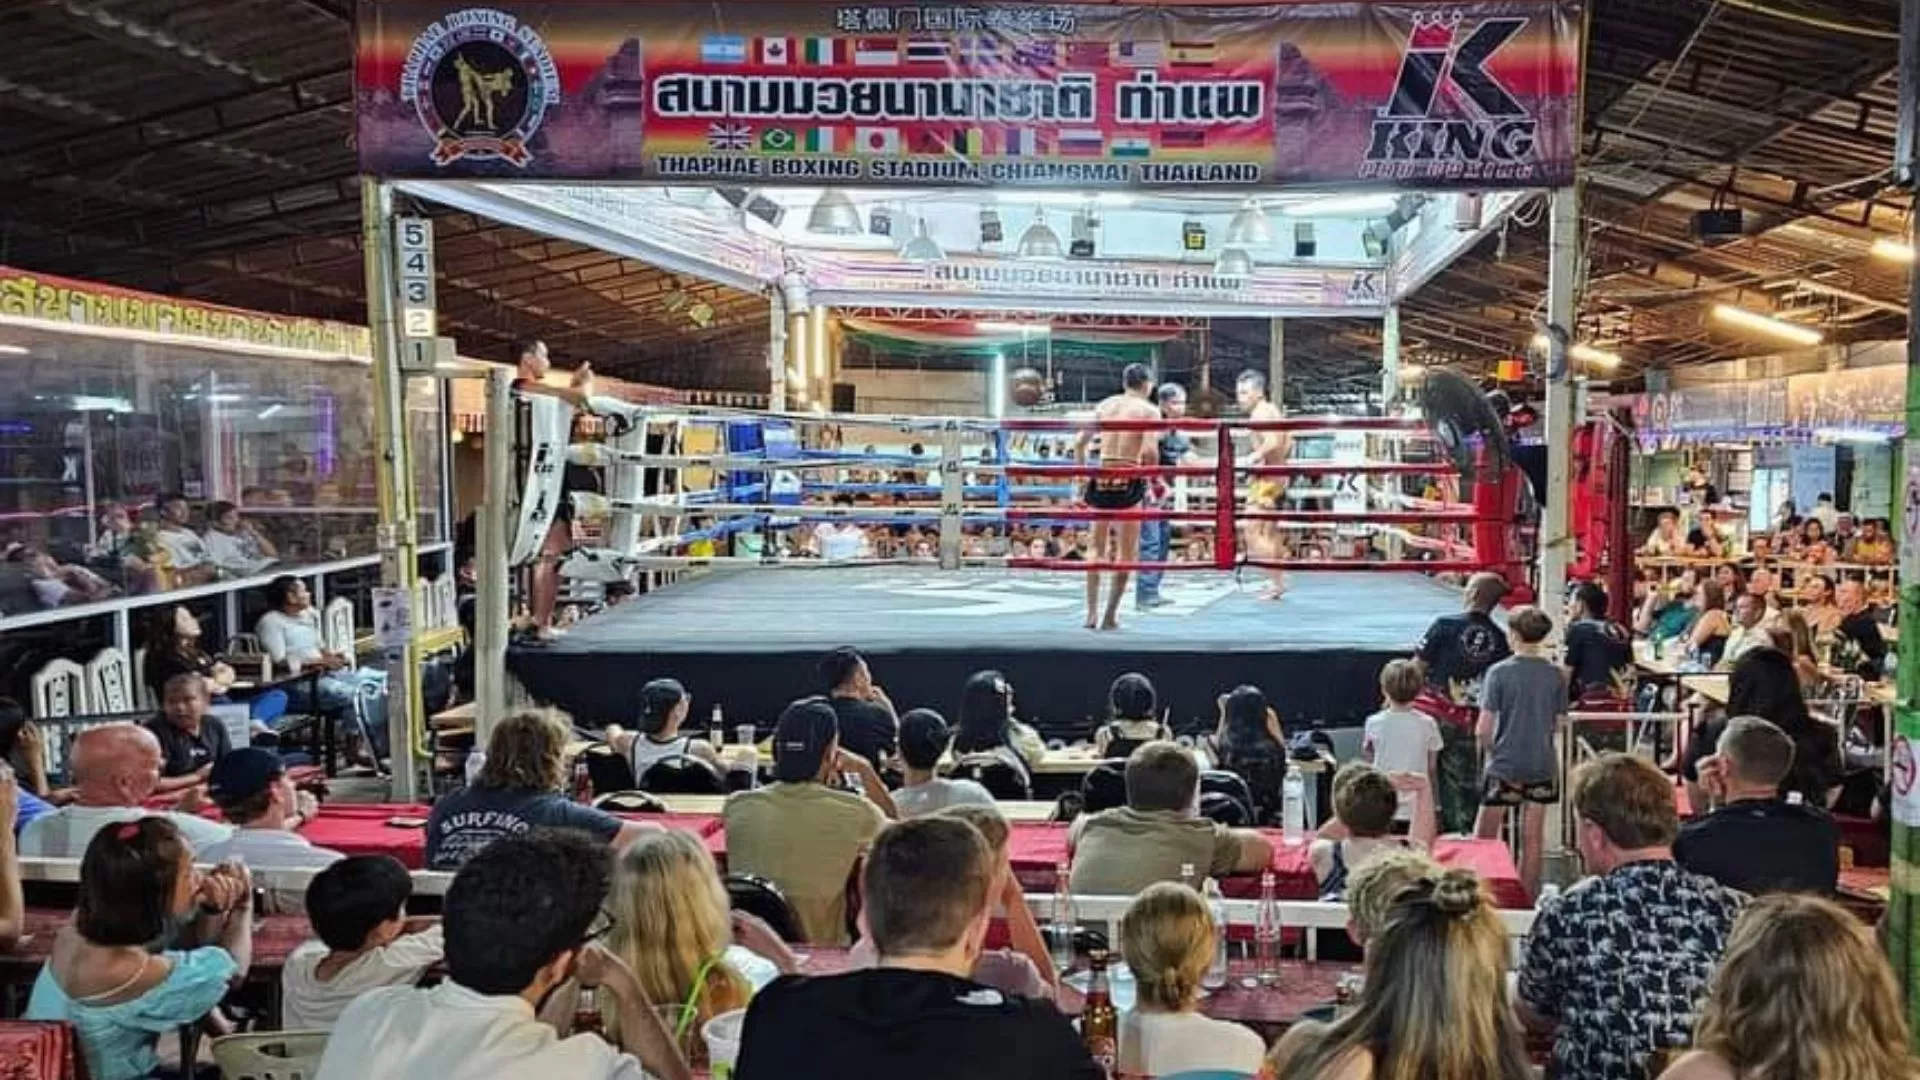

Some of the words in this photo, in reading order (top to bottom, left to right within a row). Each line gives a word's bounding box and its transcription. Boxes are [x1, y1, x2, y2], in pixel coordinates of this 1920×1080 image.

[654, 74, 1094, 120] สนามมวยนานาชาติ
[1366, 120, 1537, 162] KING
[658, 157, 760, 174] THAPHAE
[771, 158, 861, 176] BOXING
[990, 163, 1129, 181] CHIANGMAI
[405, 224, 424, 246] 5
[406, 253, 425, 273] 4
[408, 282, 426, 303] 3
[409, 312, 428, 332] 2
[415, 342, 422, 361] 1
[441, 812, 529, 834] SURFING
